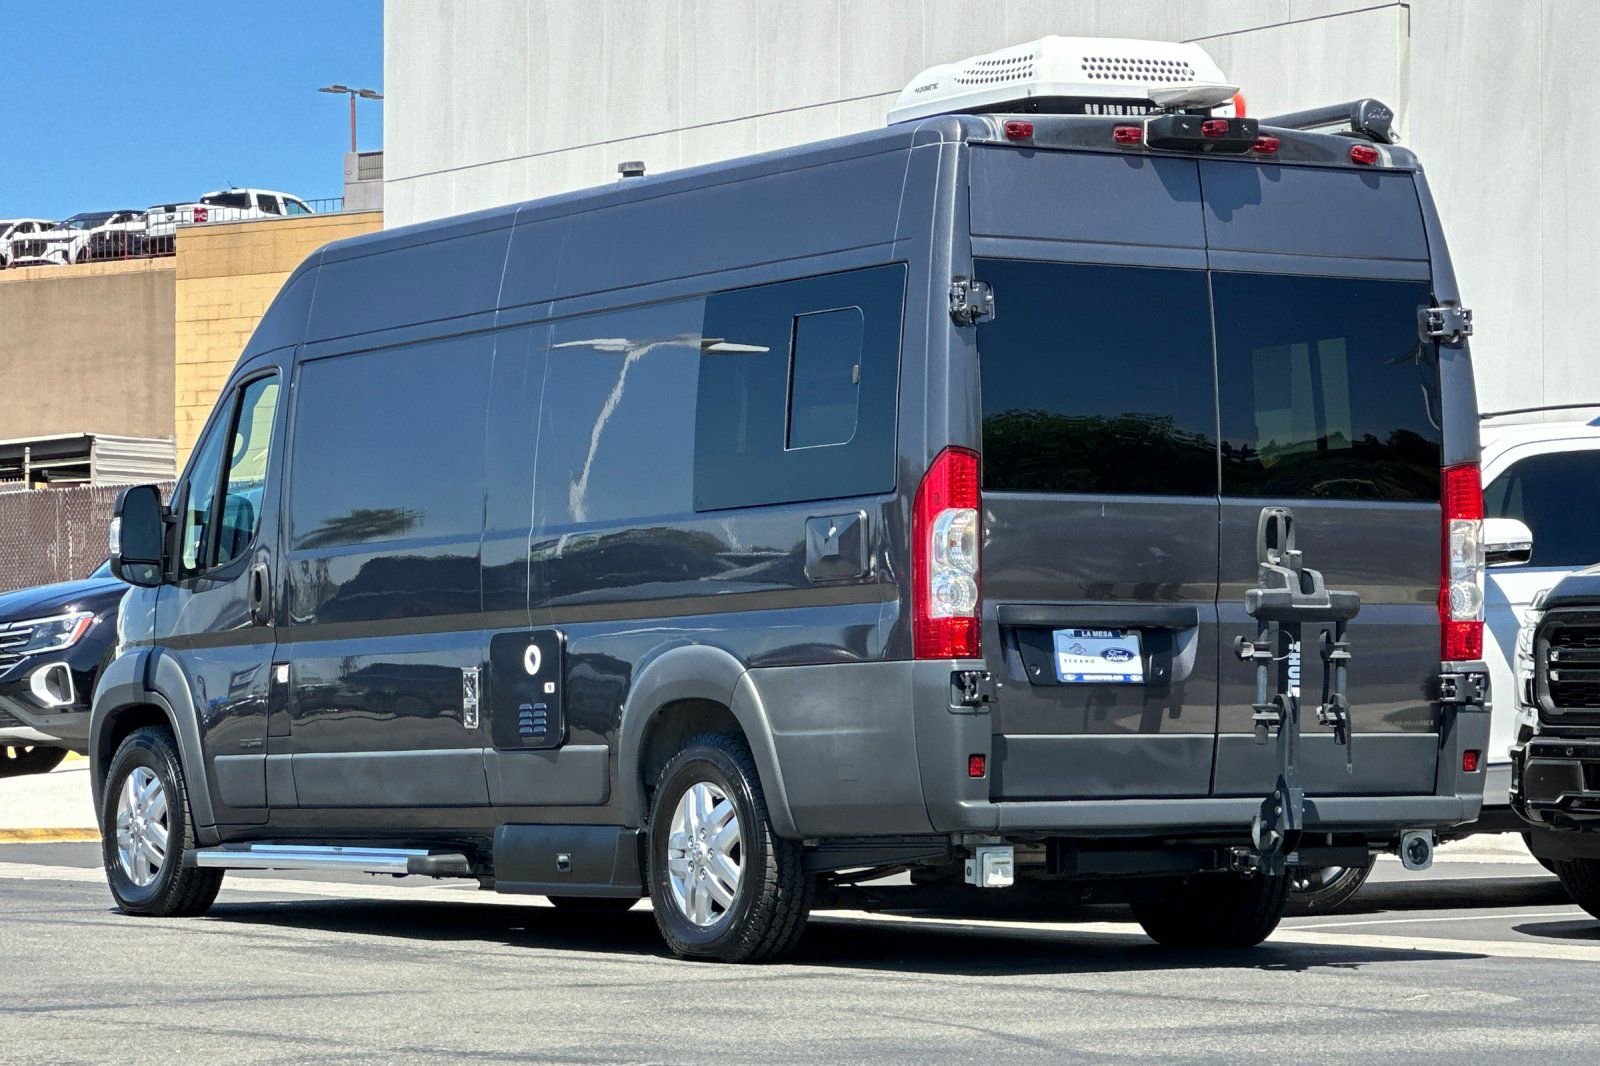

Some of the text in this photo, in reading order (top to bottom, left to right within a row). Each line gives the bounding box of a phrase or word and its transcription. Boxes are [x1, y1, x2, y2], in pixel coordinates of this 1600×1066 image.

[1081, 630, 1113, 638] LA MESA
[1105, 649, 1130, 661] Ford
[1287, 641, 1301, 698] THULE
